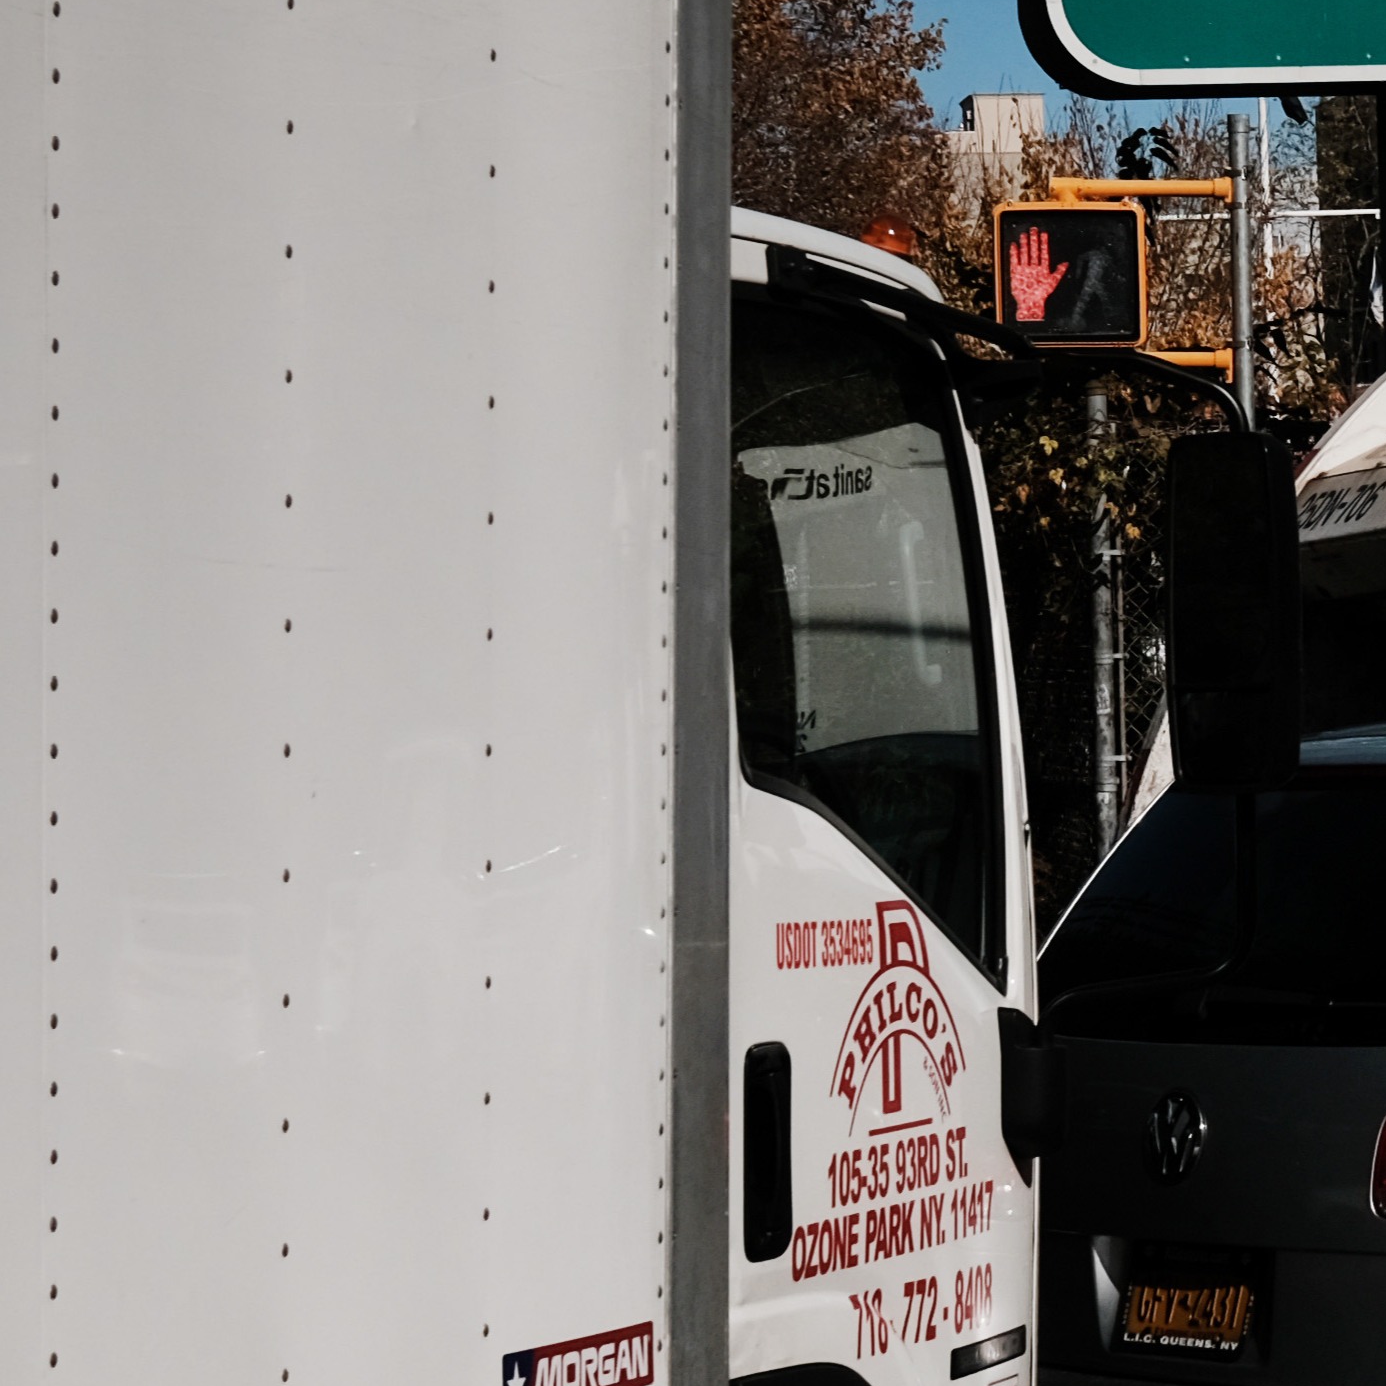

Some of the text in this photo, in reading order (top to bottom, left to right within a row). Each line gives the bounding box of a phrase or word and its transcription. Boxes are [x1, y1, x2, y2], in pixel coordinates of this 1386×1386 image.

[776, 918, 873, 969] USDOT 3534695
[838, 980, 958, 1110] PHILCO'S
[828, 1126, 968, 1208] 105-35 93RD ST.
[792, 1180, 994, 1282] OZONE PARK NY. 11417
[902, 1276, 938, 1344] 772
[954, 1262, 993, 1335] 8408
[1219, 1342, 1240, 1351] NY
